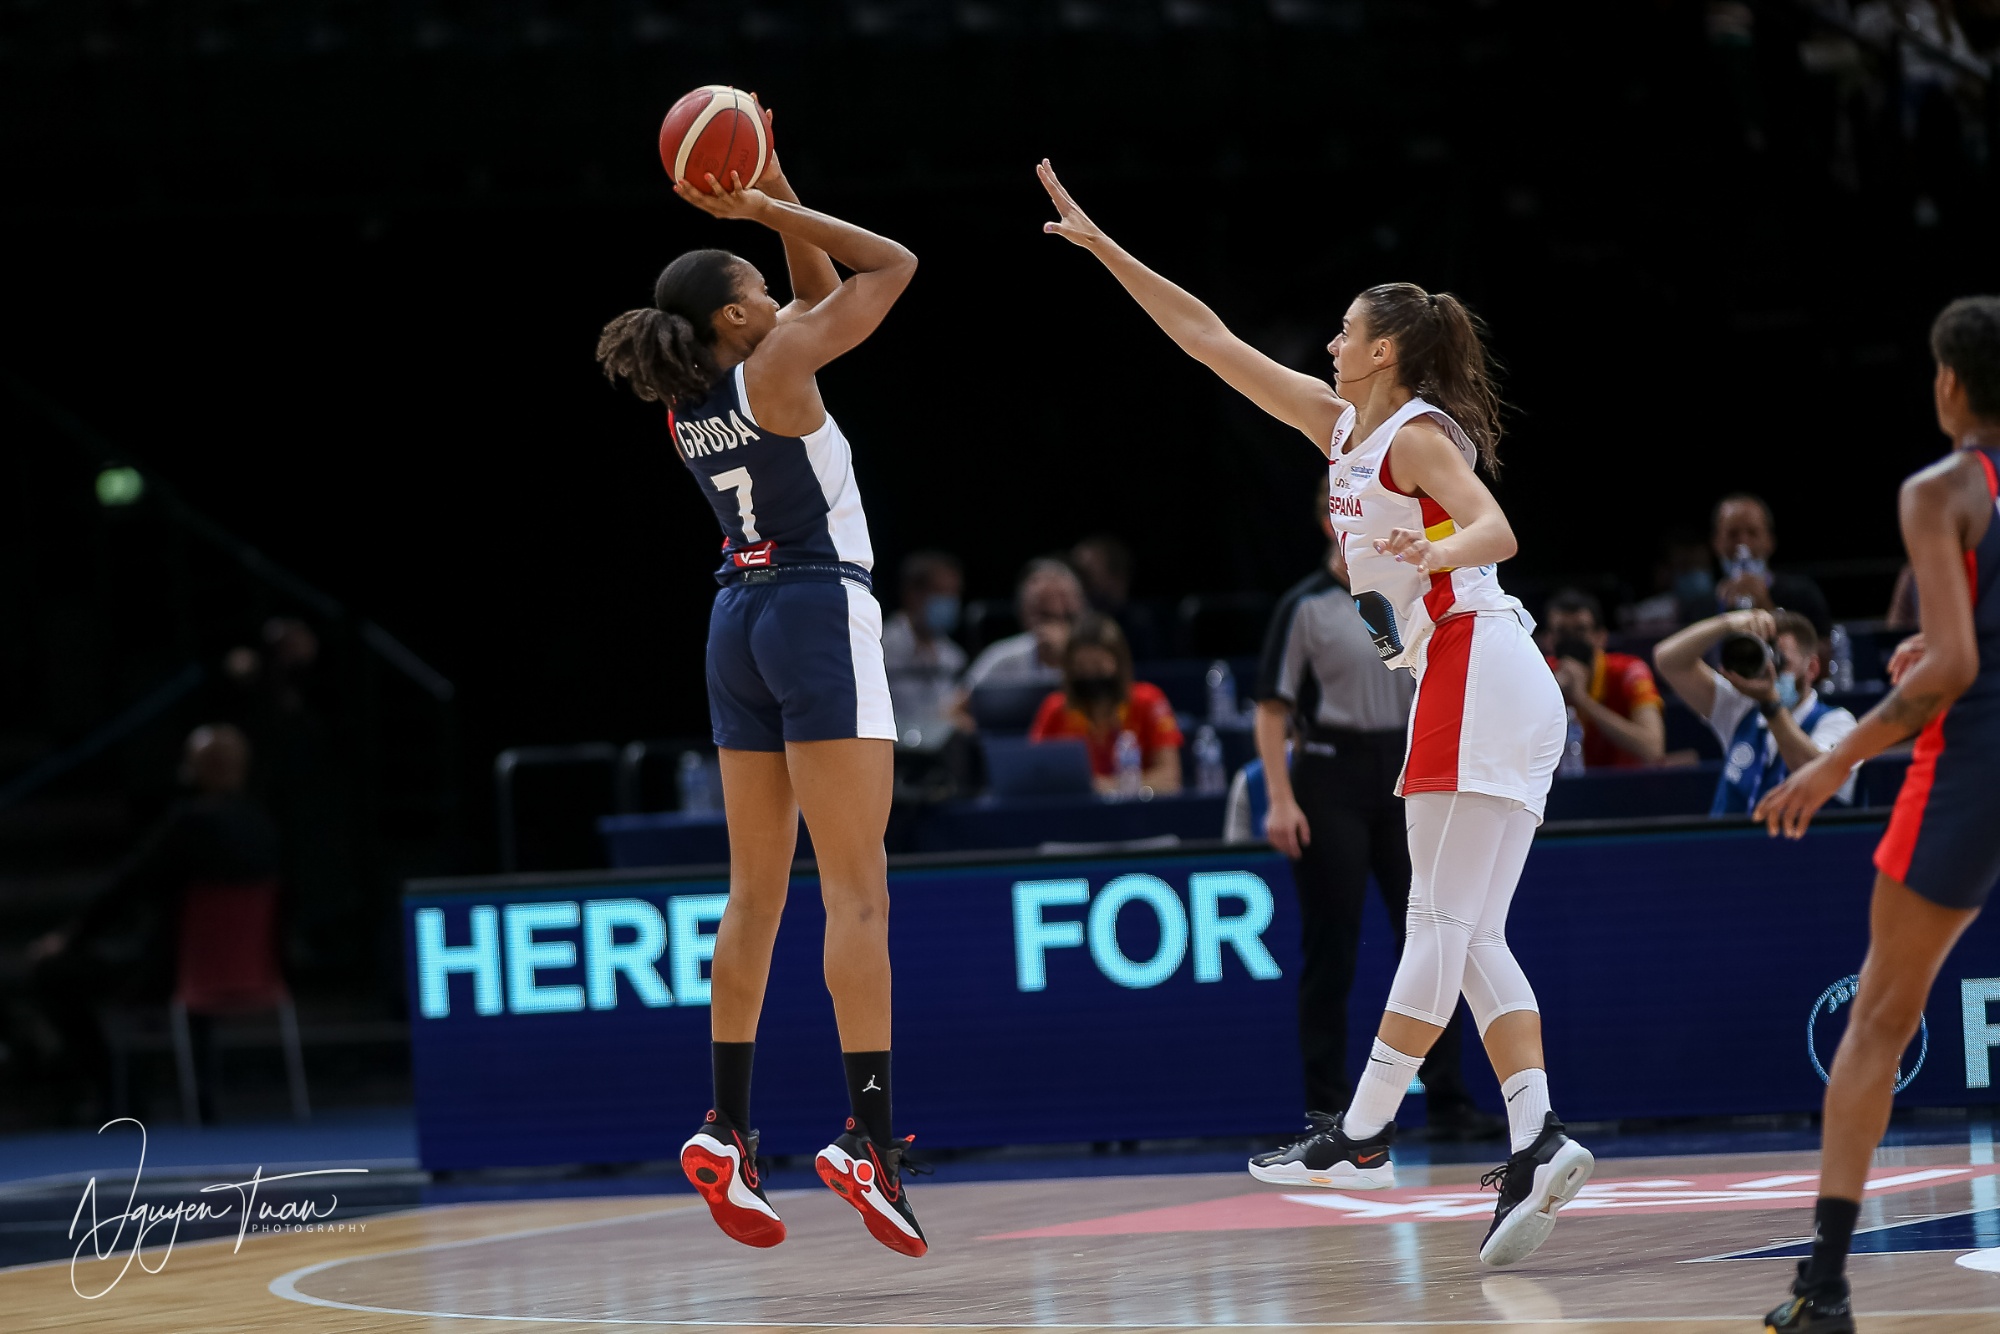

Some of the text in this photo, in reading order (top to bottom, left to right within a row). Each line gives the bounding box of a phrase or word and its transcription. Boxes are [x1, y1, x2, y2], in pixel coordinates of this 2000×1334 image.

[676, 410, 760, 459] GRUDA
[710, 466, 761, 543] 7
[414, 870, 1283, 1019] HERE FOR
